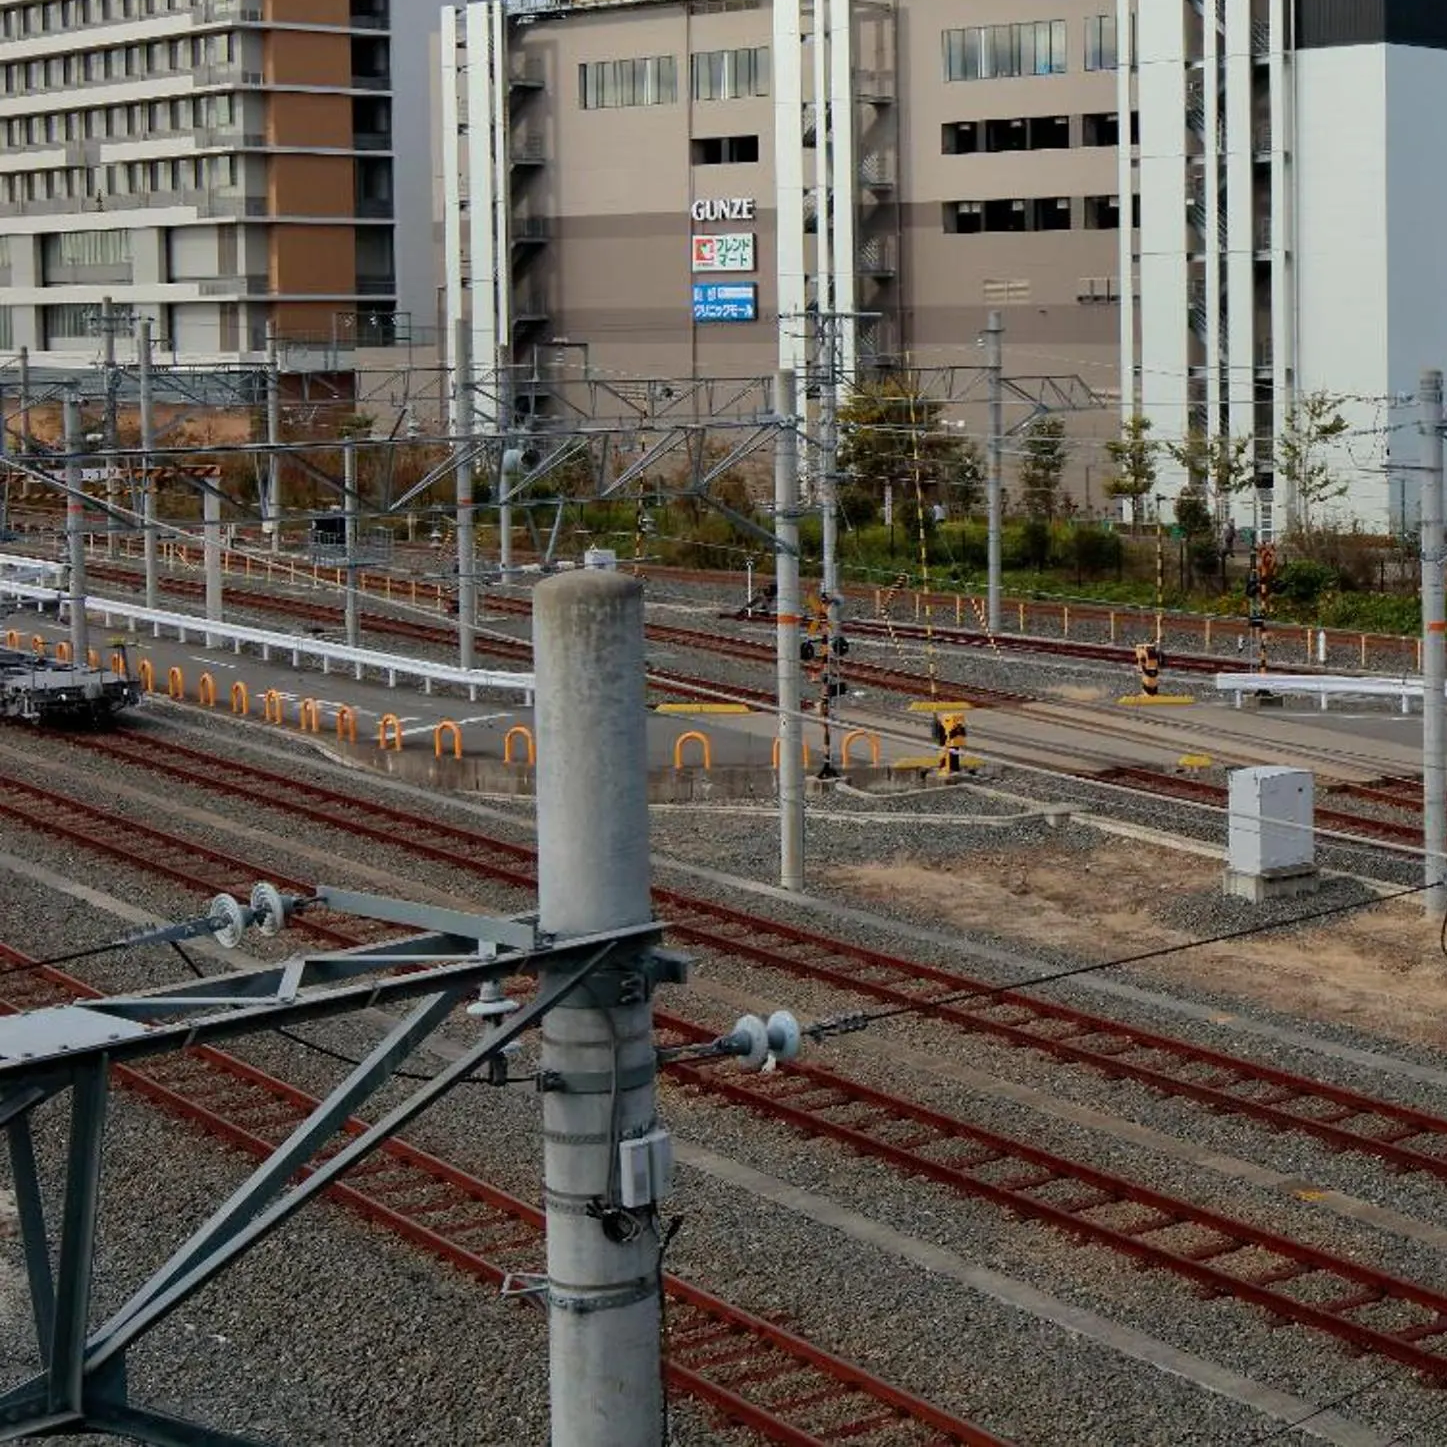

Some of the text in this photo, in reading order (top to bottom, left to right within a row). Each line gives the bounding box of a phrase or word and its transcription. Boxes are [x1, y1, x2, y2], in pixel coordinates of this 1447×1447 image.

[691, 198, 754, 221] GUNZE
[716, 237, 752, 252] フレンド
[719, 252, 748, 267] マート
[694, 303, 754, 318] クリニックモール
